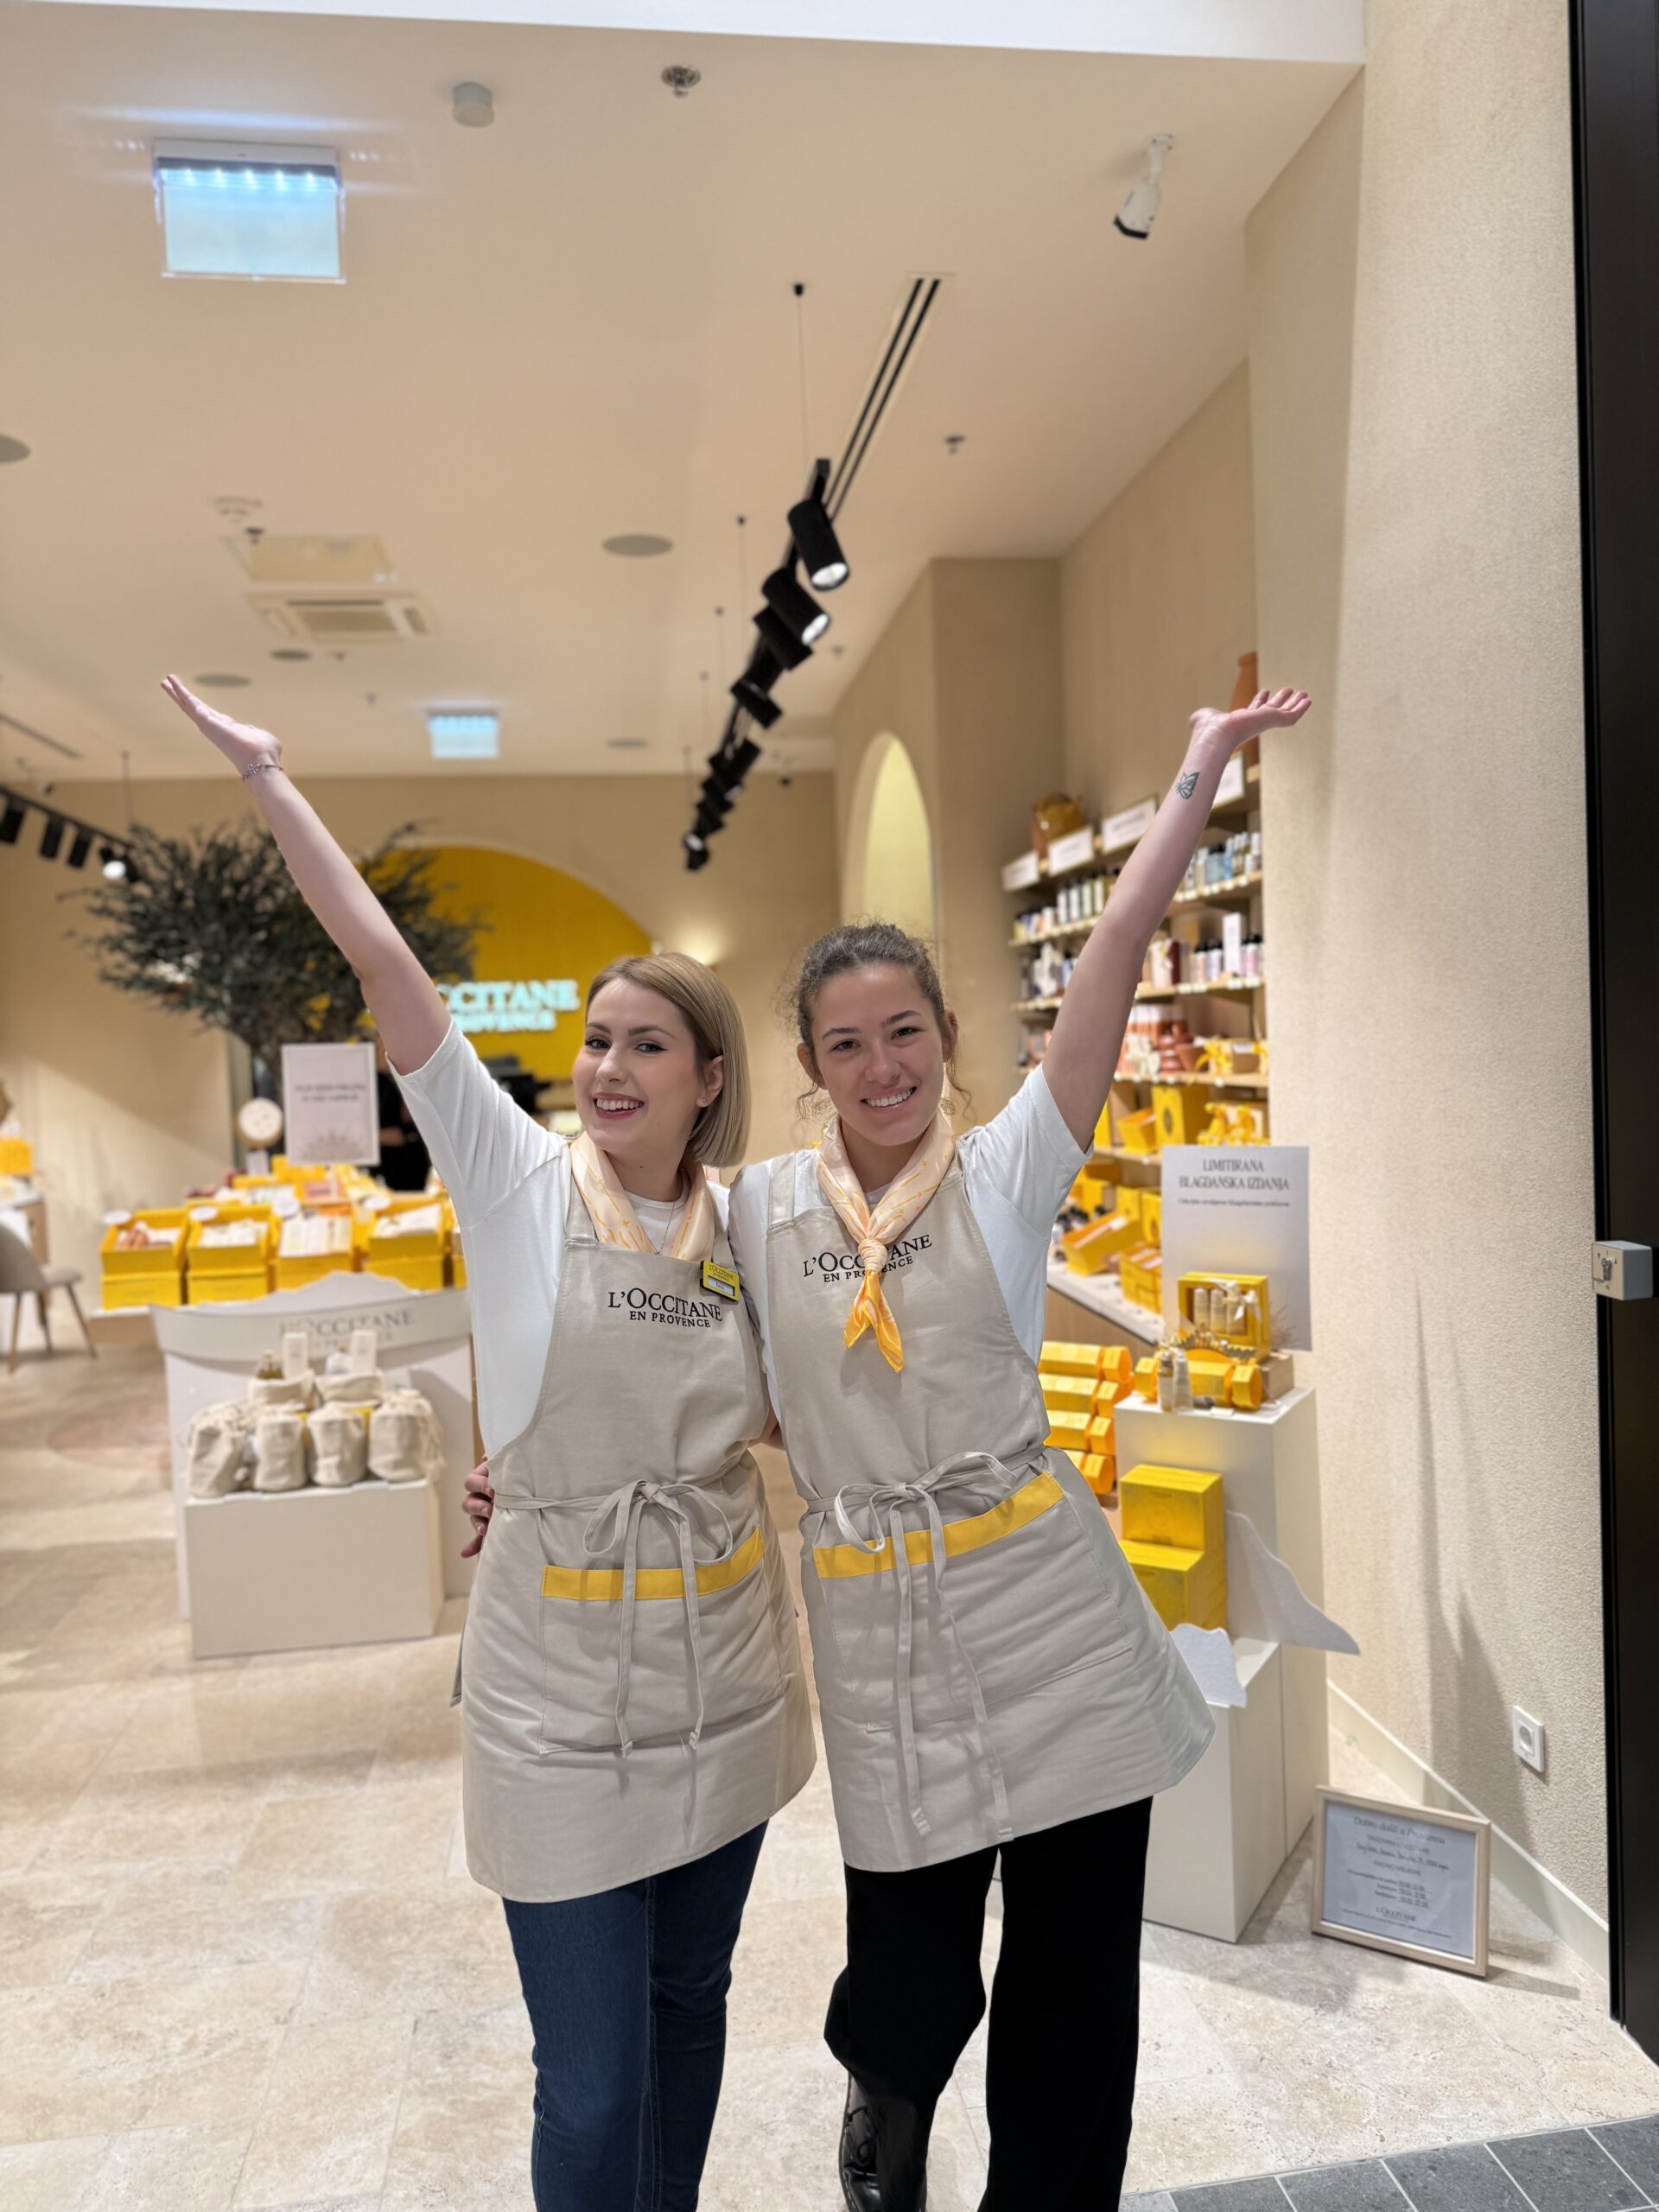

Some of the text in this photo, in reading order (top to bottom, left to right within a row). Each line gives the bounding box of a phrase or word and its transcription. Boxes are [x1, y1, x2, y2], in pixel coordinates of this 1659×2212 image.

[1203, 1159, 1265, 1172] LIMITIRANA
[1179, 1175, 1290, 1192] BLAGDANSKA IZDANJA
[803, 1235, 932, 1277] L'OCCANE
[823, 1255, 913, 1283] EN PRENCE
[607, 1287, 722, 1322] L'OCCITANE
[630, 1311, 710, 1328] EN PROVENCE
